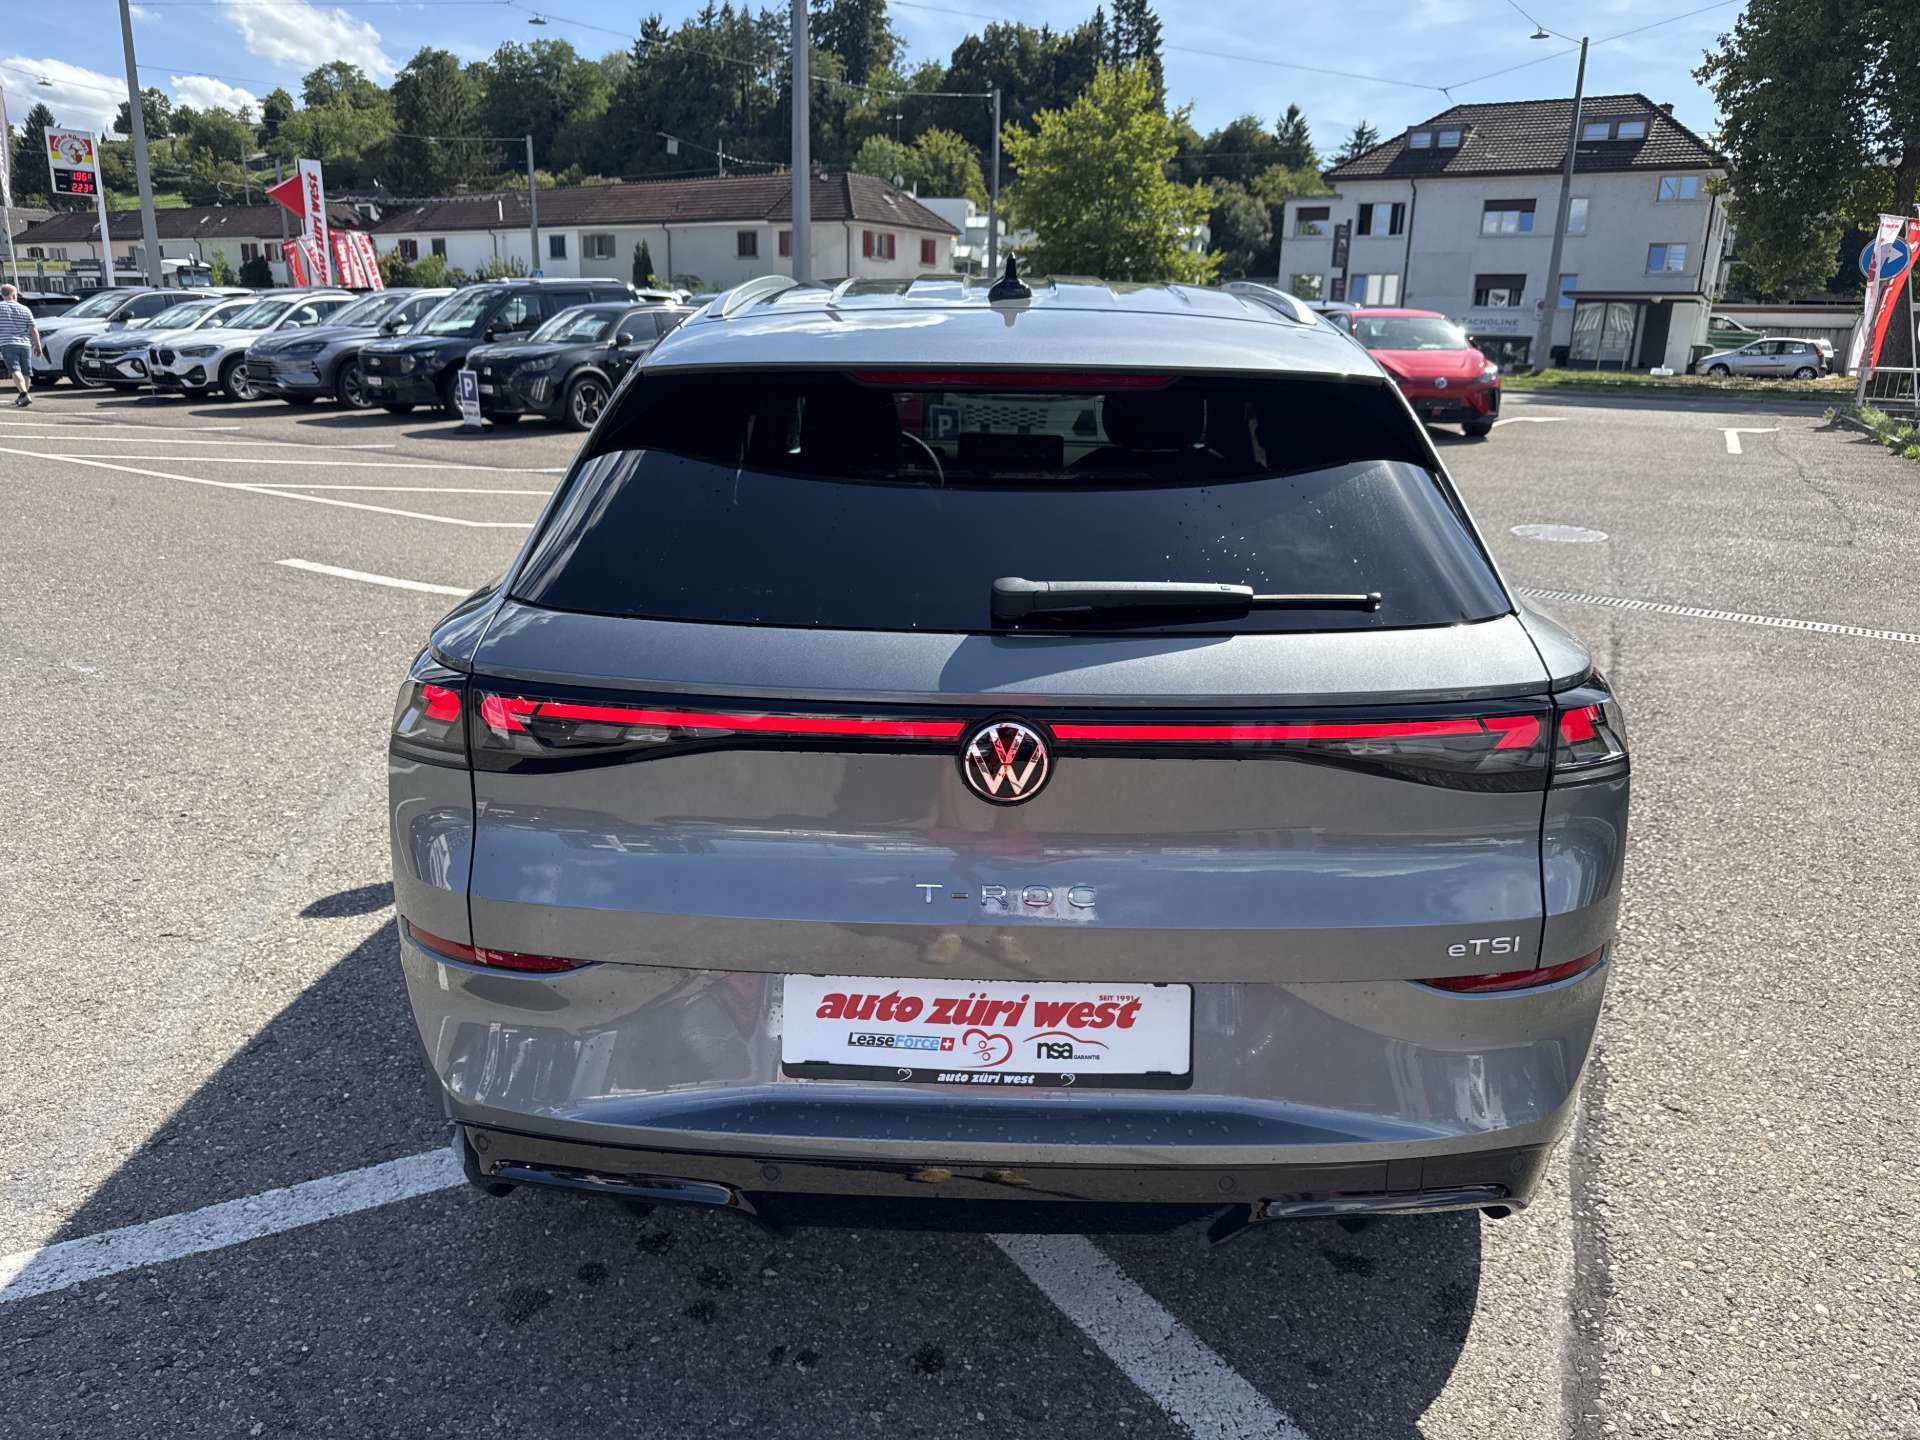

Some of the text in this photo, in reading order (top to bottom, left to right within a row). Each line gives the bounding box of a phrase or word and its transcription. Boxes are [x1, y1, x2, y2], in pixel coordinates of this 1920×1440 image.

[307, 171, 320, 212] west
[463, 377, 473, 397] P
[938, 415, 953, 437] P
[915, 883, 1096, 908] T-ROC
[1448, 935, 1520, 957] eTSI
[816, 989, 1142, 1029] auto züri west
[848, 1031, 940, 1050] LeaseForce
[1036, 1041, 1073, 1060] nsa
[937, 1072, 1036, 1085] auto züri west
